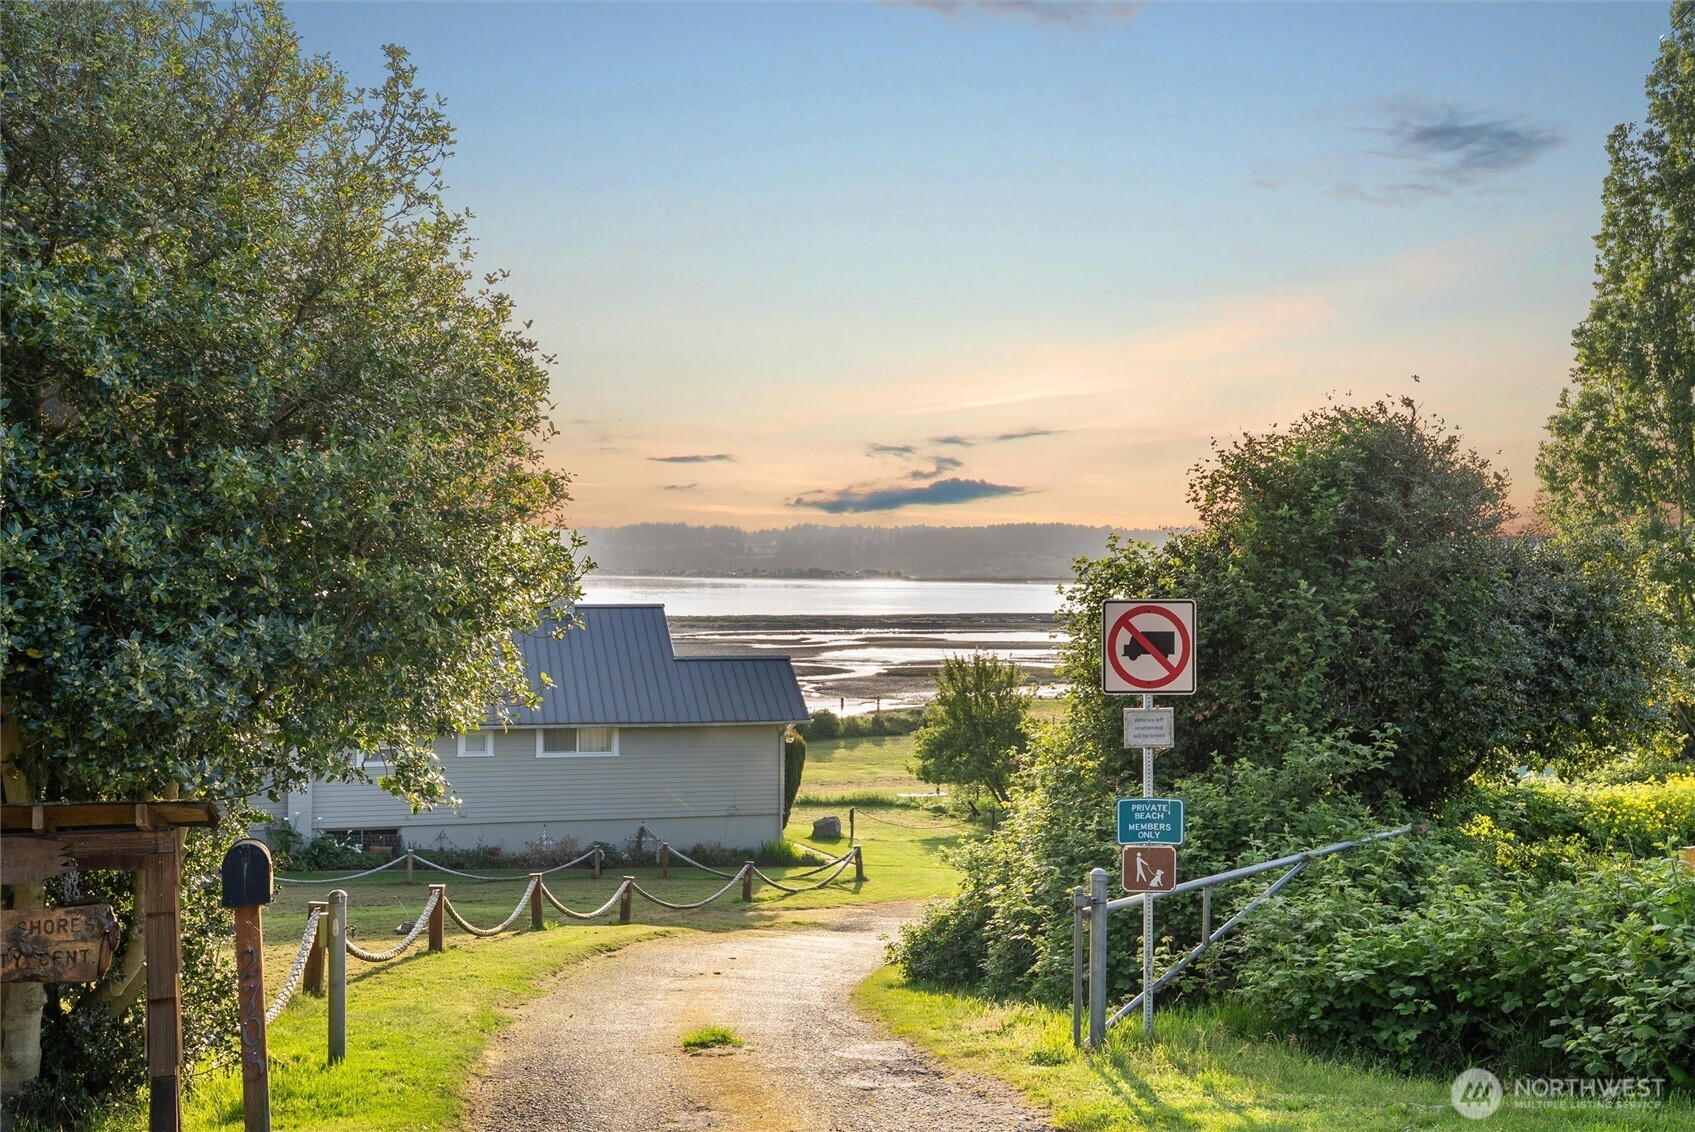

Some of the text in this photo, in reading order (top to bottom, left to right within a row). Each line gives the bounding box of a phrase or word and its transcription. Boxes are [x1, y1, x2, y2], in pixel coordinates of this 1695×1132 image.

[1131, 804, 1168, 812] PRIVATE
[1134, 812, 1164, 820] BEACH
[1128, 823, 1172, 831] MEMBERS
[1137, 831, 1161, 839] ONLY
[16, 918, 95, 936] SHORES
